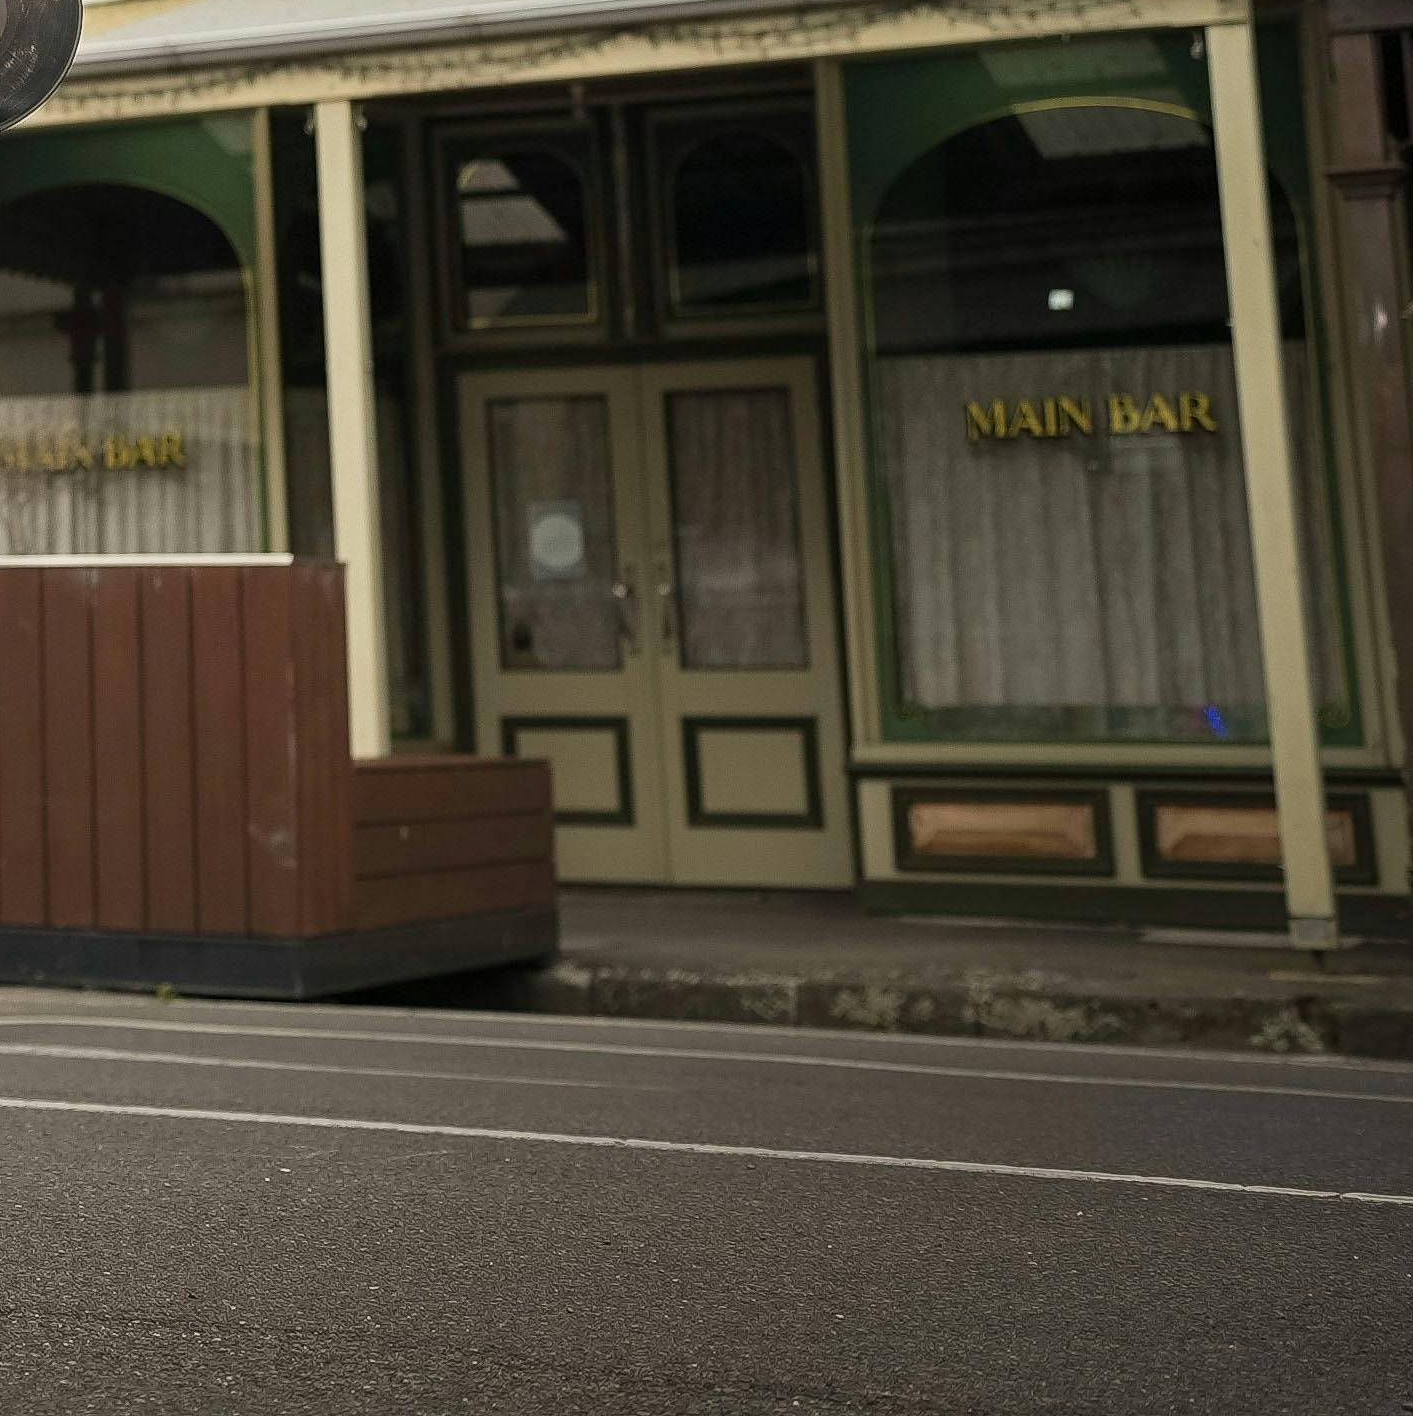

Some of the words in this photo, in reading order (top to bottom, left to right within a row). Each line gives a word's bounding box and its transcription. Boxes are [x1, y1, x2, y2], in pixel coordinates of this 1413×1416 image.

[965, 392, 1094, 441] MAIN
[1107, 391, 1218, 434] BAR
[103, 431, 185, 470] BAR
